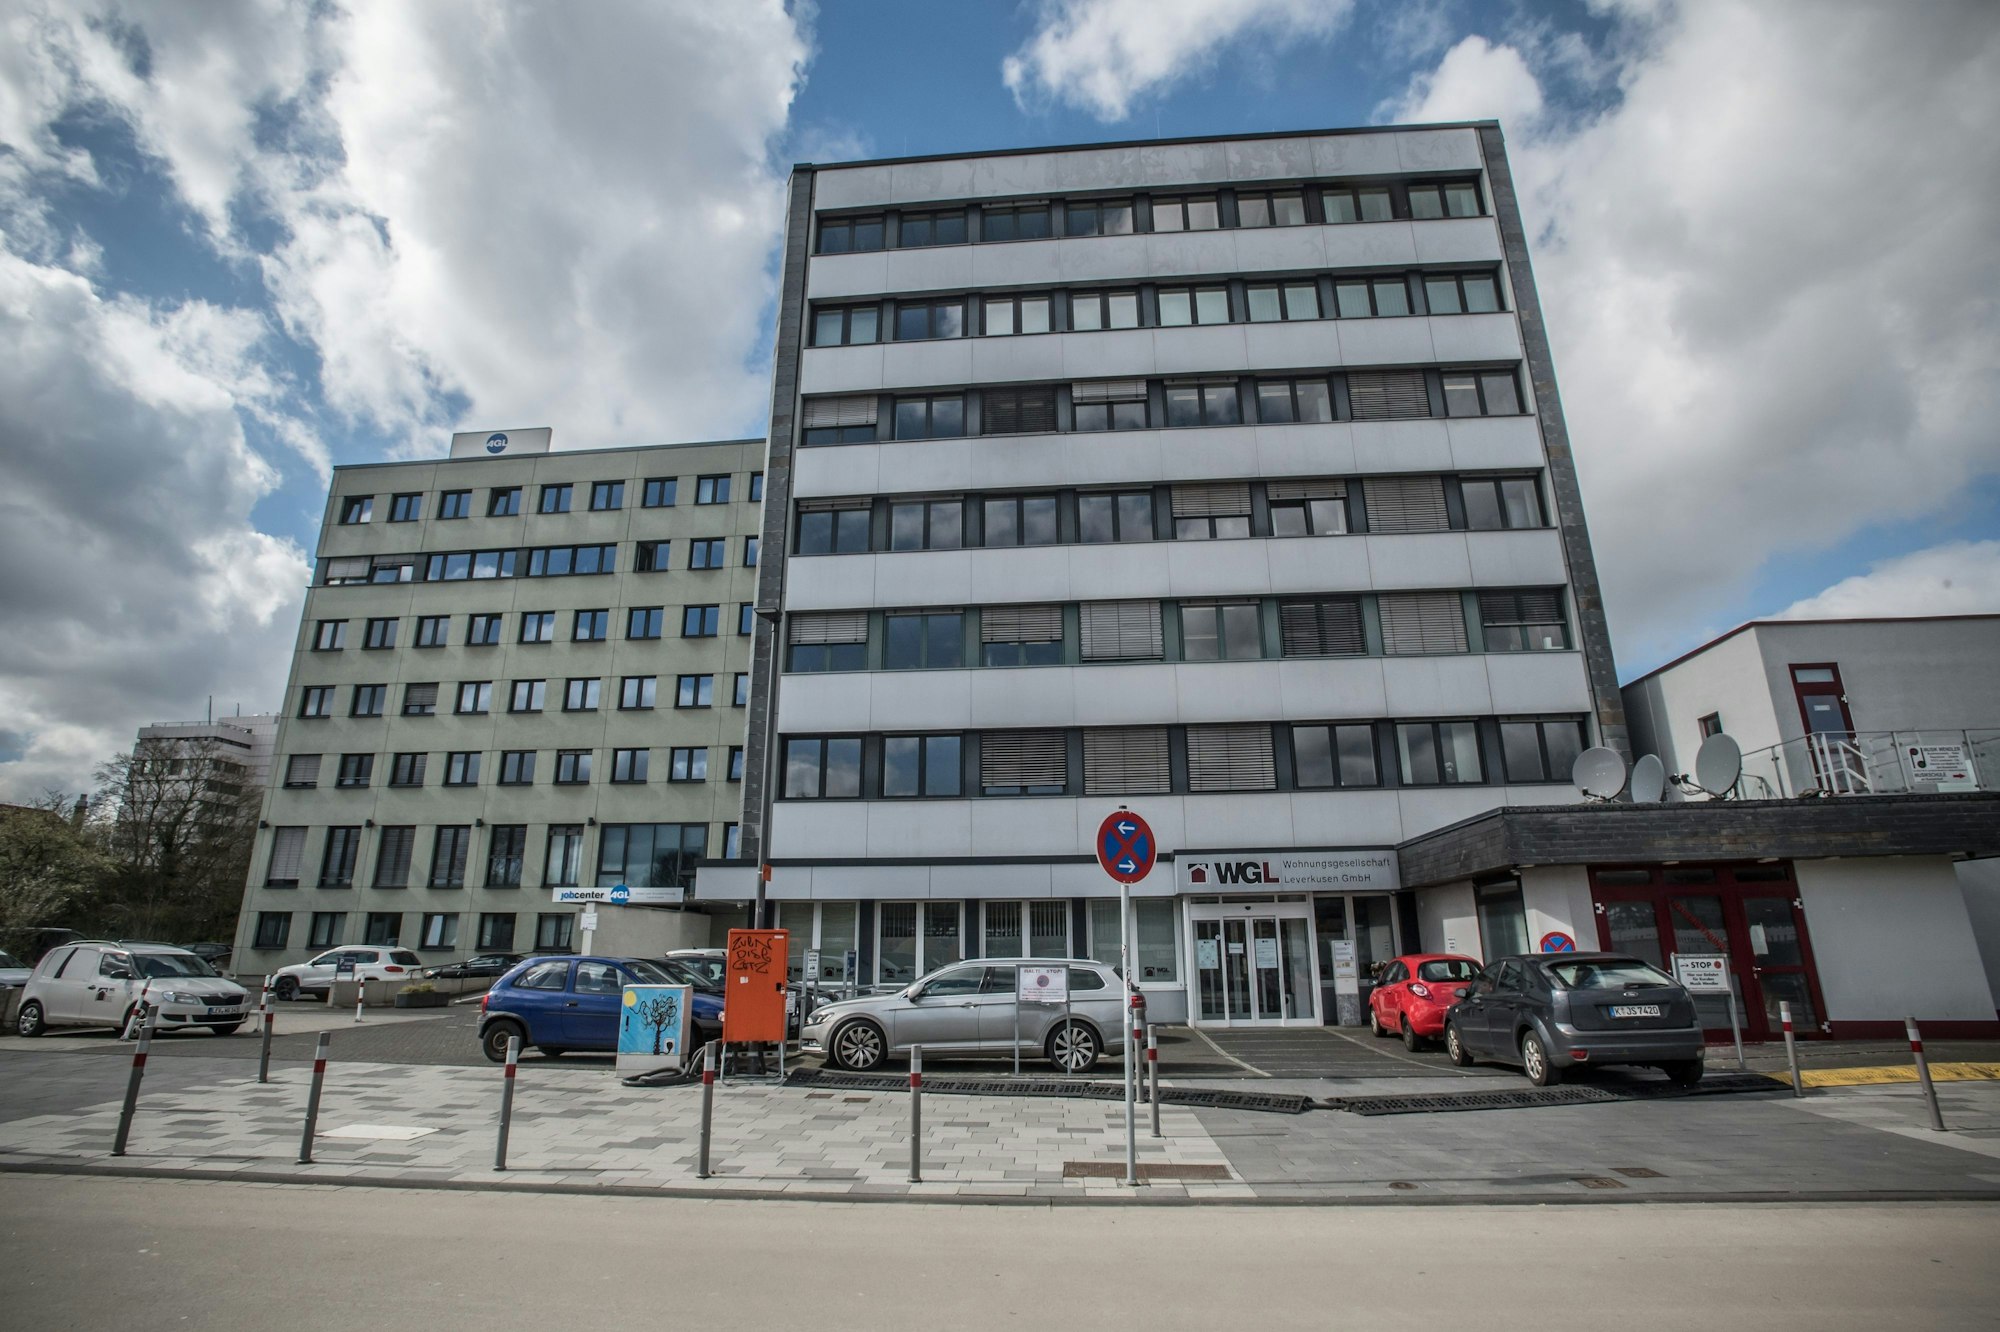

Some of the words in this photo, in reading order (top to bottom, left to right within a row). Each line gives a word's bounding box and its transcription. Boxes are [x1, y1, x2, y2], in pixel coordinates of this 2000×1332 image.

[486, 439, 508, 448] AGL
[1214, 861, 1280, 884] WGL
[1282, 858, 1391, 869] Wohnungsgesellschaft
[1284, 875, 1339, 884] Leverkusen
[1341, 874, 1372, 883] GmbH
[560, 891, 605, 901] jobcenter
[610, 890, 630, 899] AGL
[1690, 961, 1712, 969] STOP
[1614, 1007, 1622, 1016] K
